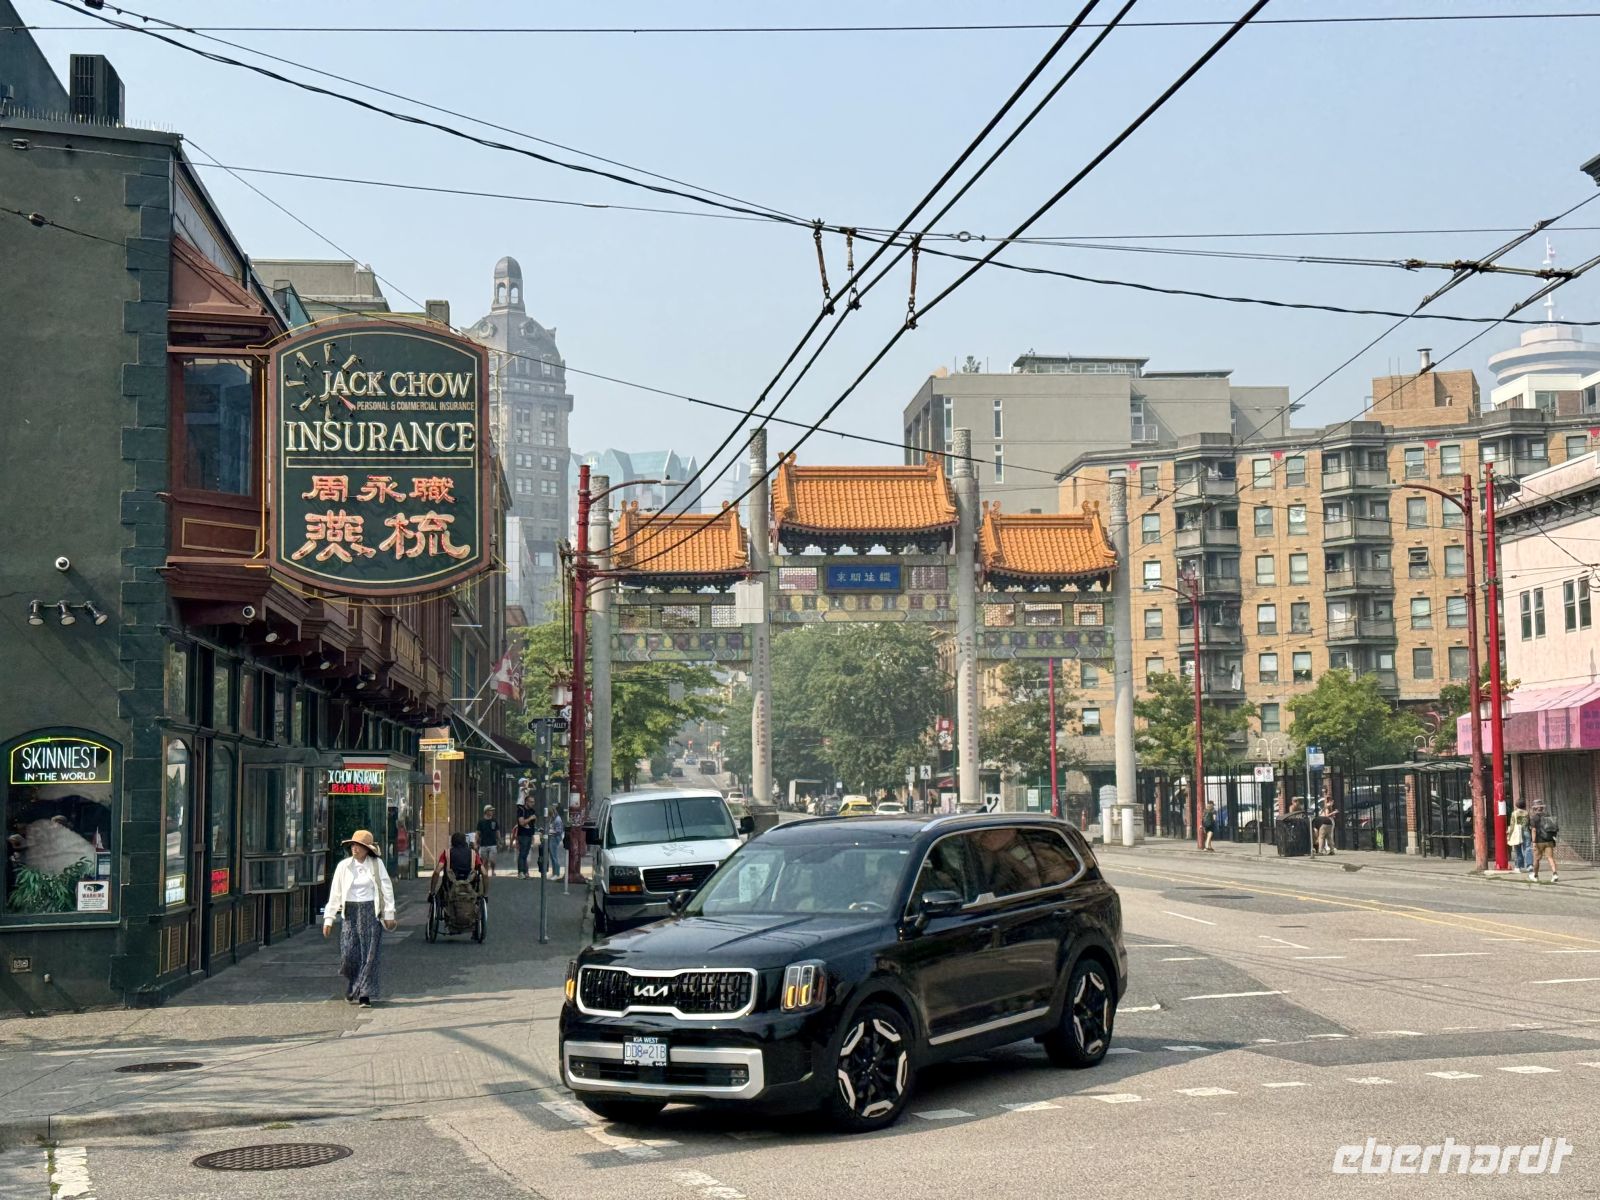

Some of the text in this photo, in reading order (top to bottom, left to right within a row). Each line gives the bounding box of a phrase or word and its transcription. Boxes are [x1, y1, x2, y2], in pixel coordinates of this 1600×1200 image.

[319, 370, 472, 400] JACK CHOW
[356, 401, 475, 411] PERSONAL & COMMERCIAL INSURANCE
[285, 421, 476, 452] INSURANCE
[302, 475, 457, 503] 周永職
[22, 746, 100, 770] SKINNIEST
[24, 771, 96, 781] IN THE WORLD
[335, 770, 352, 784] CHOW
[353, 770, 384, 785] INSURANCE
[633, 985, 669, 997] KIA
